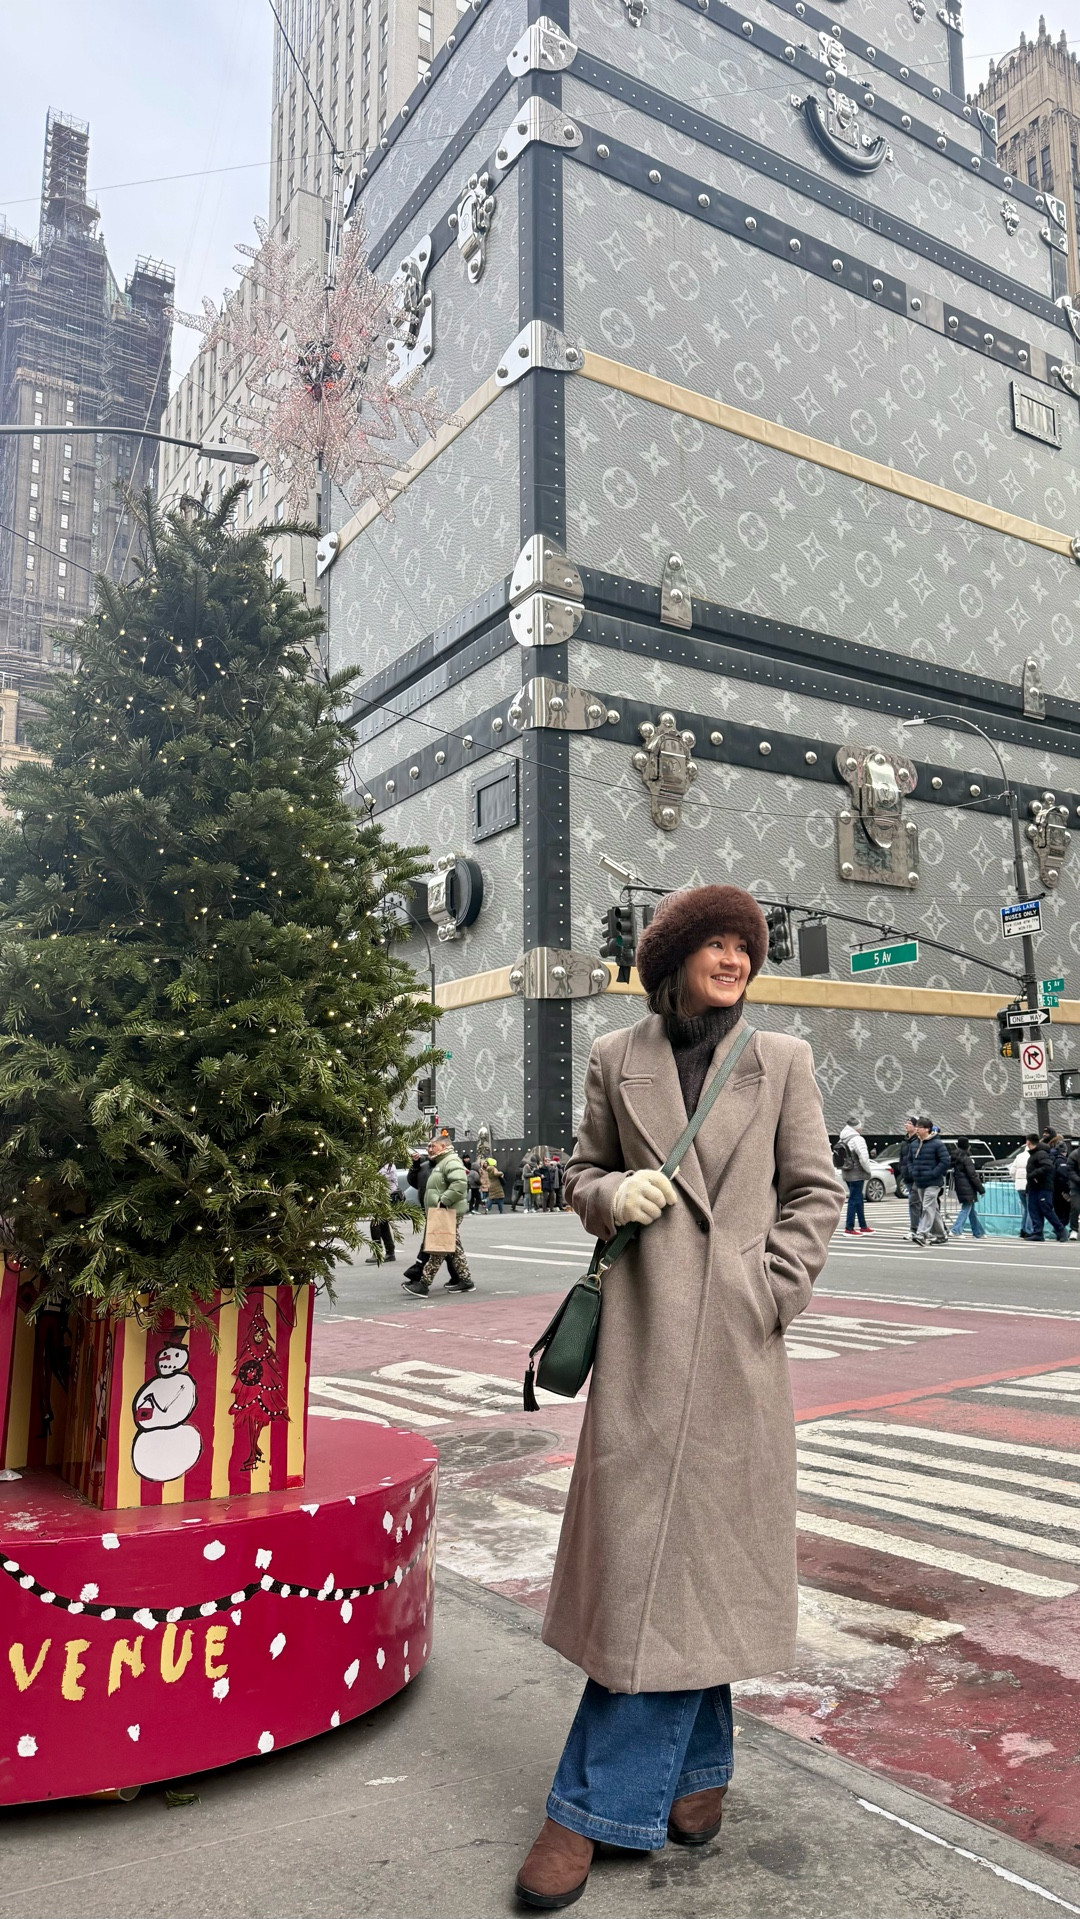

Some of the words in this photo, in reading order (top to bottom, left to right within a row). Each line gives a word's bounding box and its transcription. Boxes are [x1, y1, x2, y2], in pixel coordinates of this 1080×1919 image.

[1004, 913, 1022, 921] BUSES
[874, 952, 879, 965] 5
[882, 951, 891, 963] Av
[1047, 982, 1052, 991] 5
[1047, 996, 1053, 1006] 57
[9, 1623, 230, 1702] VENUE
